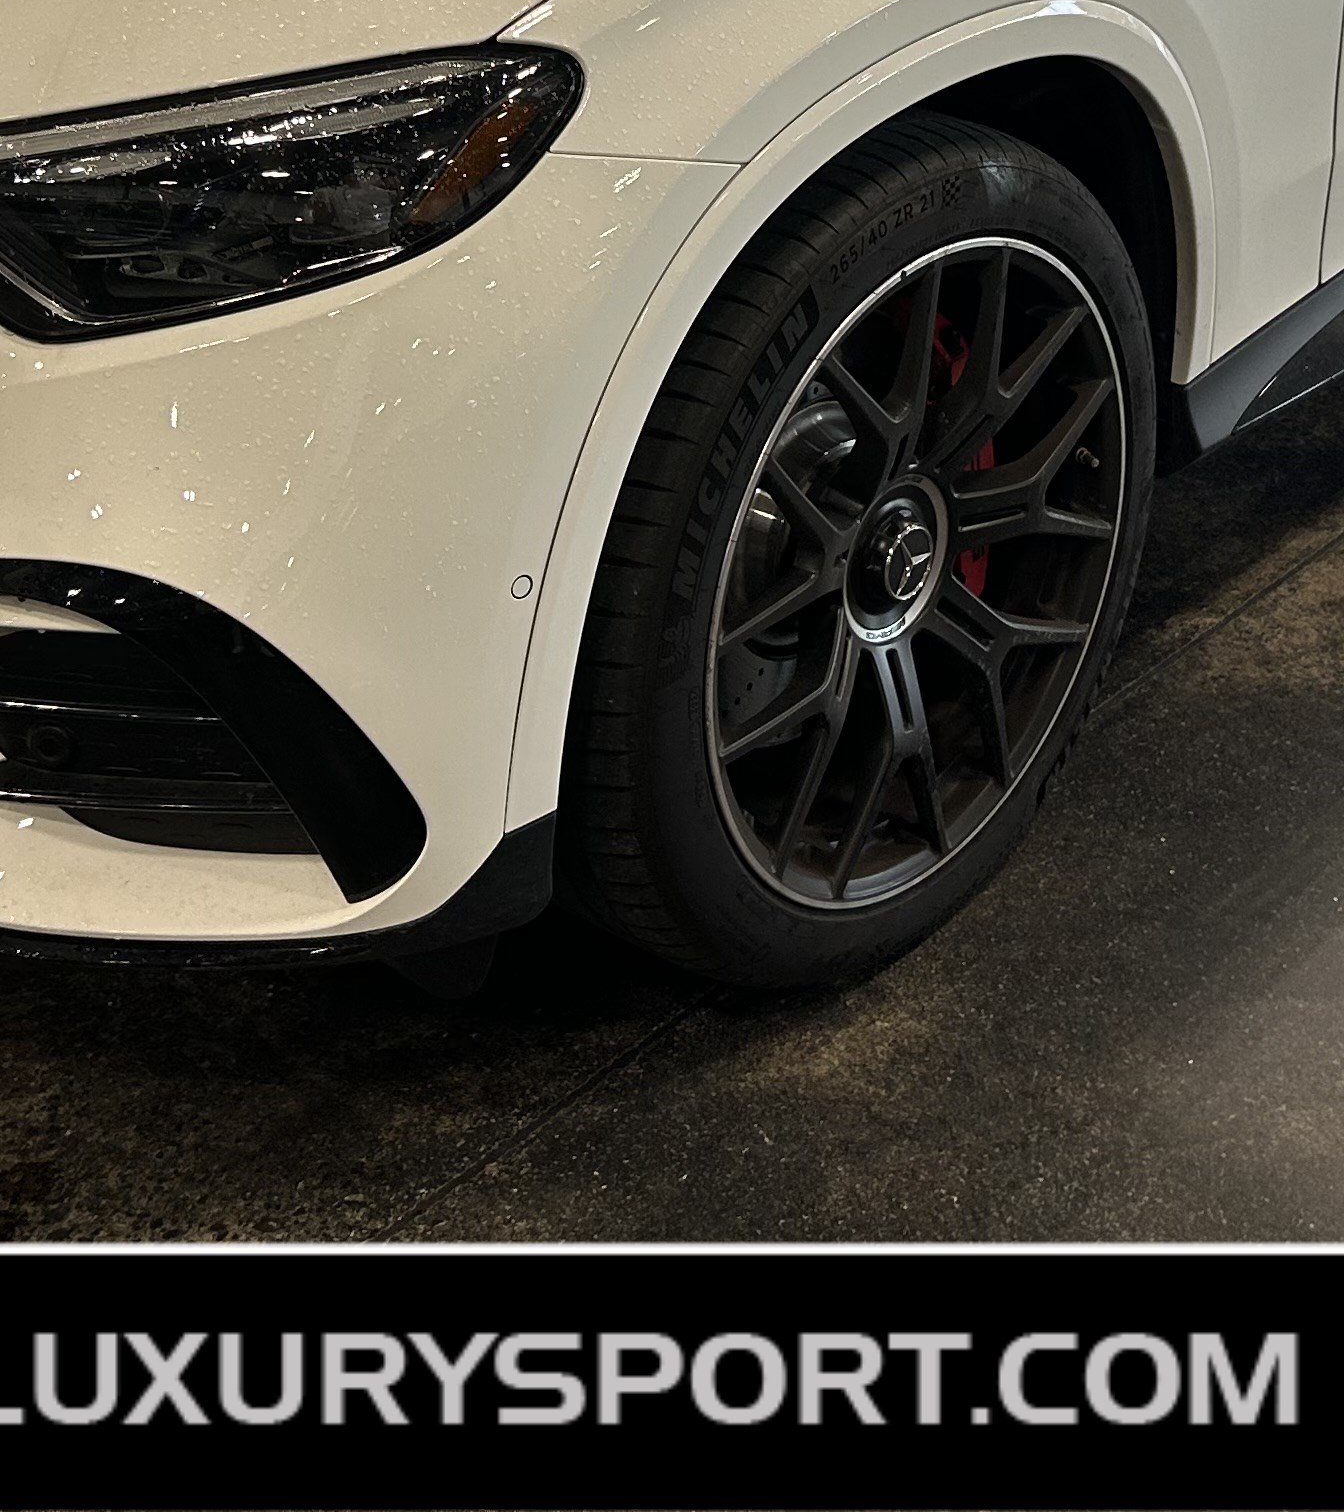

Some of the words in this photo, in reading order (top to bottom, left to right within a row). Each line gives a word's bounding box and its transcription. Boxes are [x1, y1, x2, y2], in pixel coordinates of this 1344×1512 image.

[829, 221, 888, 284] 265/40
[893, 203, 914, 230] ZR
[919, 190, 935, 213] 21
[672, 308, 809, 601] MICHELIN
